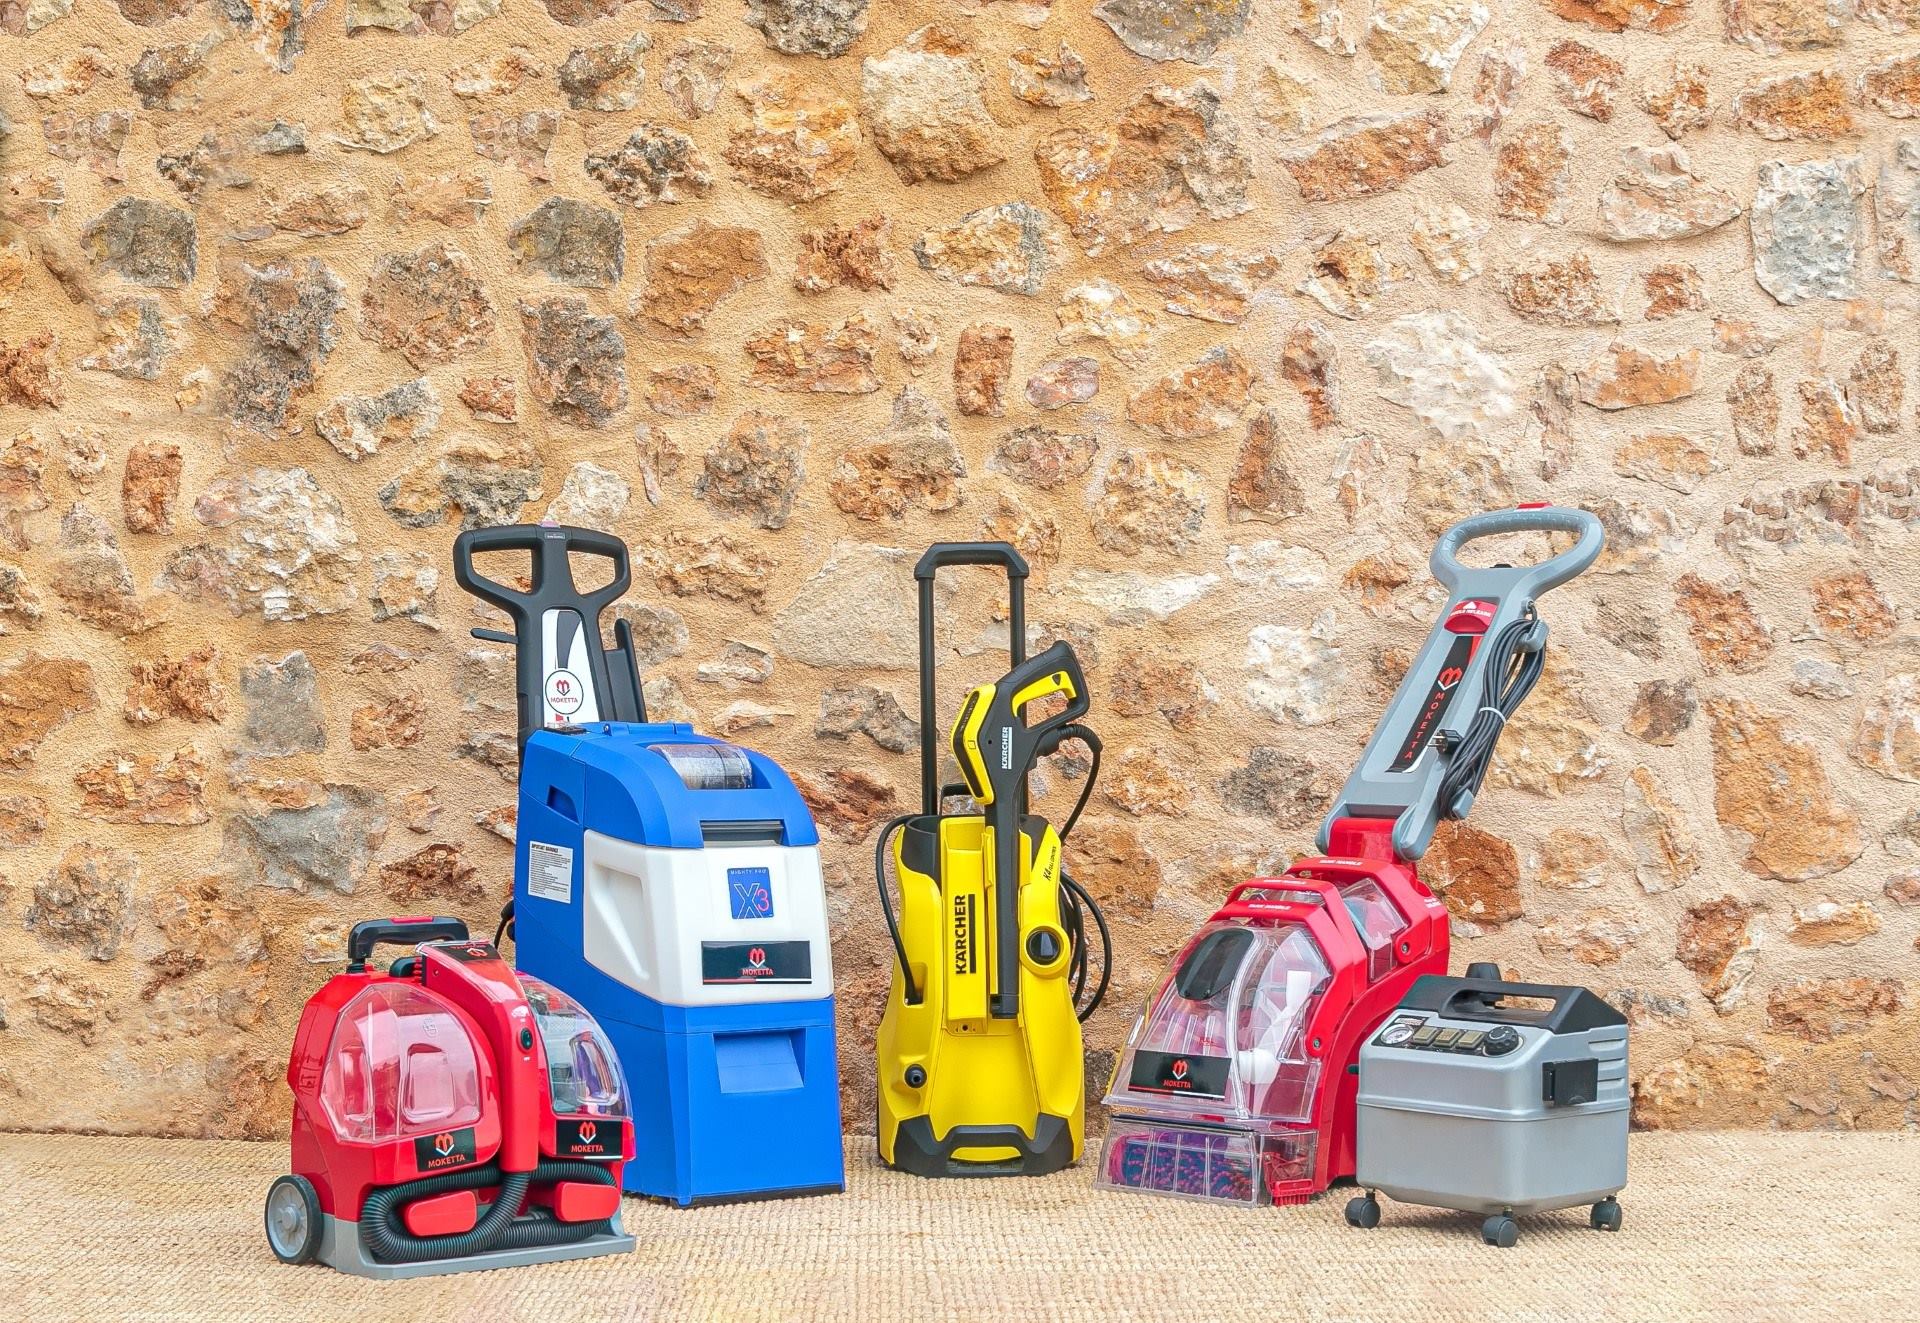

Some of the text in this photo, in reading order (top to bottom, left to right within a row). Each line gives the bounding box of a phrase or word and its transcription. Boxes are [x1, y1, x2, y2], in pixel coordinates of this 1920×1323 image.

[1404, 691, 1445, 759] MOKETTA
[954, 894, 967, 975] KÄRCHER
[742, 968, 774, 976] MOKETTA
[1163, 1079, 1191, 1089] MOKETTA
[571, 1144, 604, 1153] MOKETTA
[427, 1154, 466, 1169] MOKETTA
